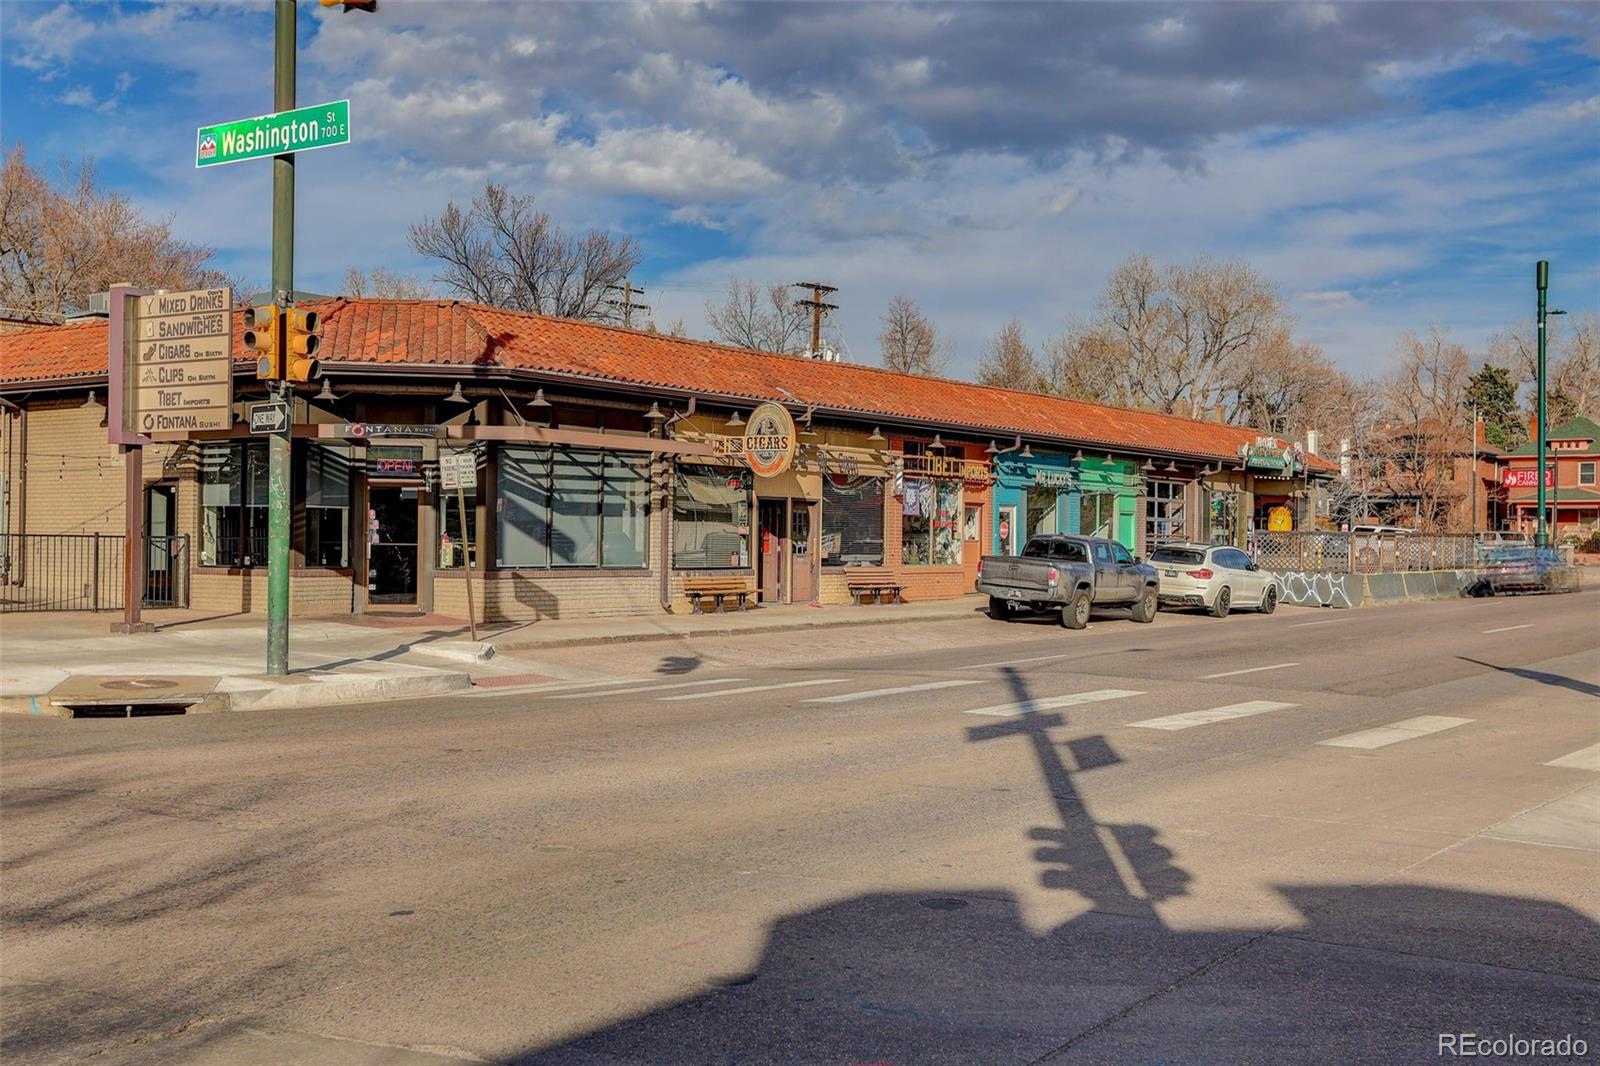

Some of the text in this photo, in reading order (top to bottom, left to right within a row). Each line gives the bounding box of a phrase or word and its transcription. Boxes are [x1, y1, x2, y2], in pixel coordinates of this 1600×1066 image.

[326, 111, 336, 123] St
[222, 119, 318, 157] Washington
[321, 123, 345, 139] 700 E
[158, 294, 224, 315] MIXED DRINKS
[158, 319, 224, 338] SANDWICHES
[158, 344, 191, 360] CIGARS
[158, 366, 184, 383] CLIPS
[157, 390, 183, 407] TIBET
[156, 414, 198, 429] FONTANA
[254, 413, 265, 425] ONE
[345, 423, 412, 436] FONTANA
[746, 436, 788, 450] CIGARS
[378, 460, 412, 472] OPEN
[925, 450, 956, 477] TIBET
